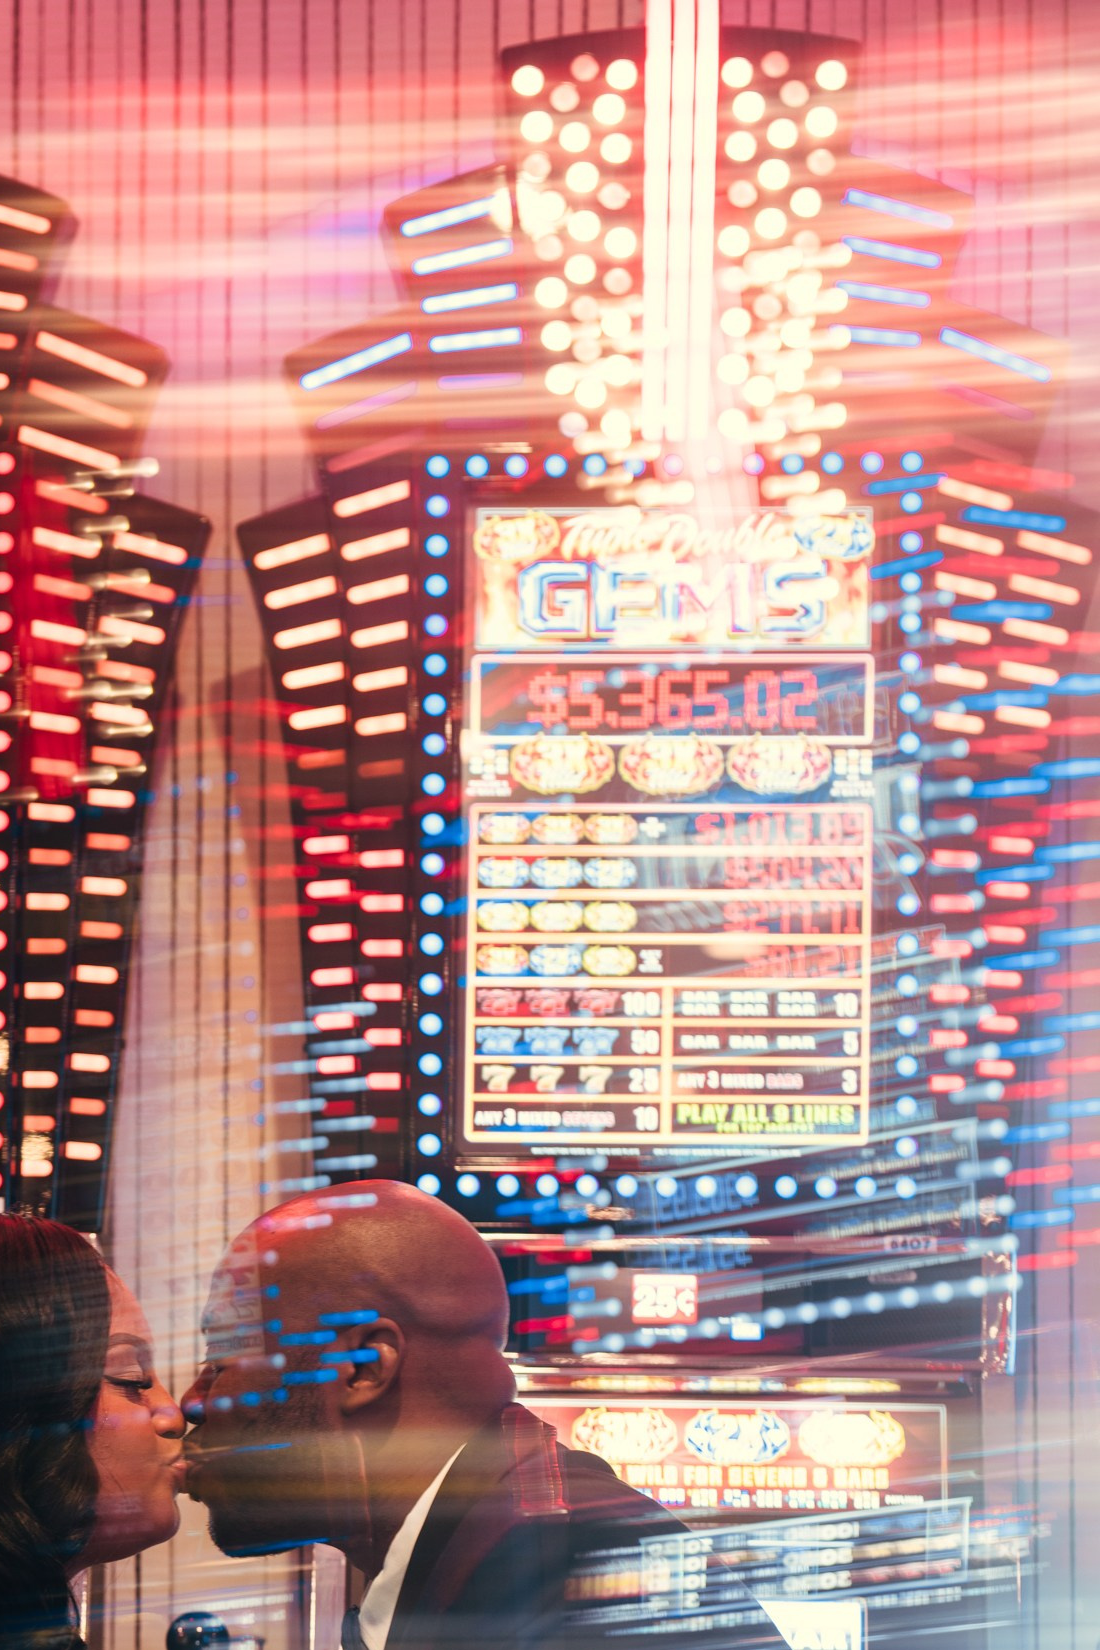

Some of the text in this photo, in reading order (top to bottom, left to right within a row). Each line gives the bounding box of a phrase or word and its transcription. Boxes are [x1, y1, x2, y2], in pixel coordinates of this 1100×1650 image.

[518, 558, 829, 638] GEMS
[526, 669, 819, 730] $5,365.02
[680, 1035, 720, 1049] BAR
[729, 1035, 768, 1049] BAR
[777, 1035, 816, 1049] BAR
[628, 1067, 659, 1093] 25
[677, 1073, 706, 1089] ANY
[706, 1070, 720, 1089] 3
[721, 1073, 765, 1089] MIXED
[841, 1069, 858, 1094] 3
[474, 1110, 503, 1126] ANY
[503, 1107, 516, 1126] 3
[517, 1110, 561, 1126] MIXED
[632, 1106, 659, 1131] 10
[677, 1104, 729, 1124] PLAY
[731, 1104, 770, 1125] ALL
[792, 1104, 855, 1126] LINES
[632, 1285, 695, 1318] 25¢
[627, 1464, 679, 1486] WILD
[684, 1465, 722, 1486] FOR
[728, 1466, 808, 1488] SEVENS
[834, 1467, 889, 1489] BARS
